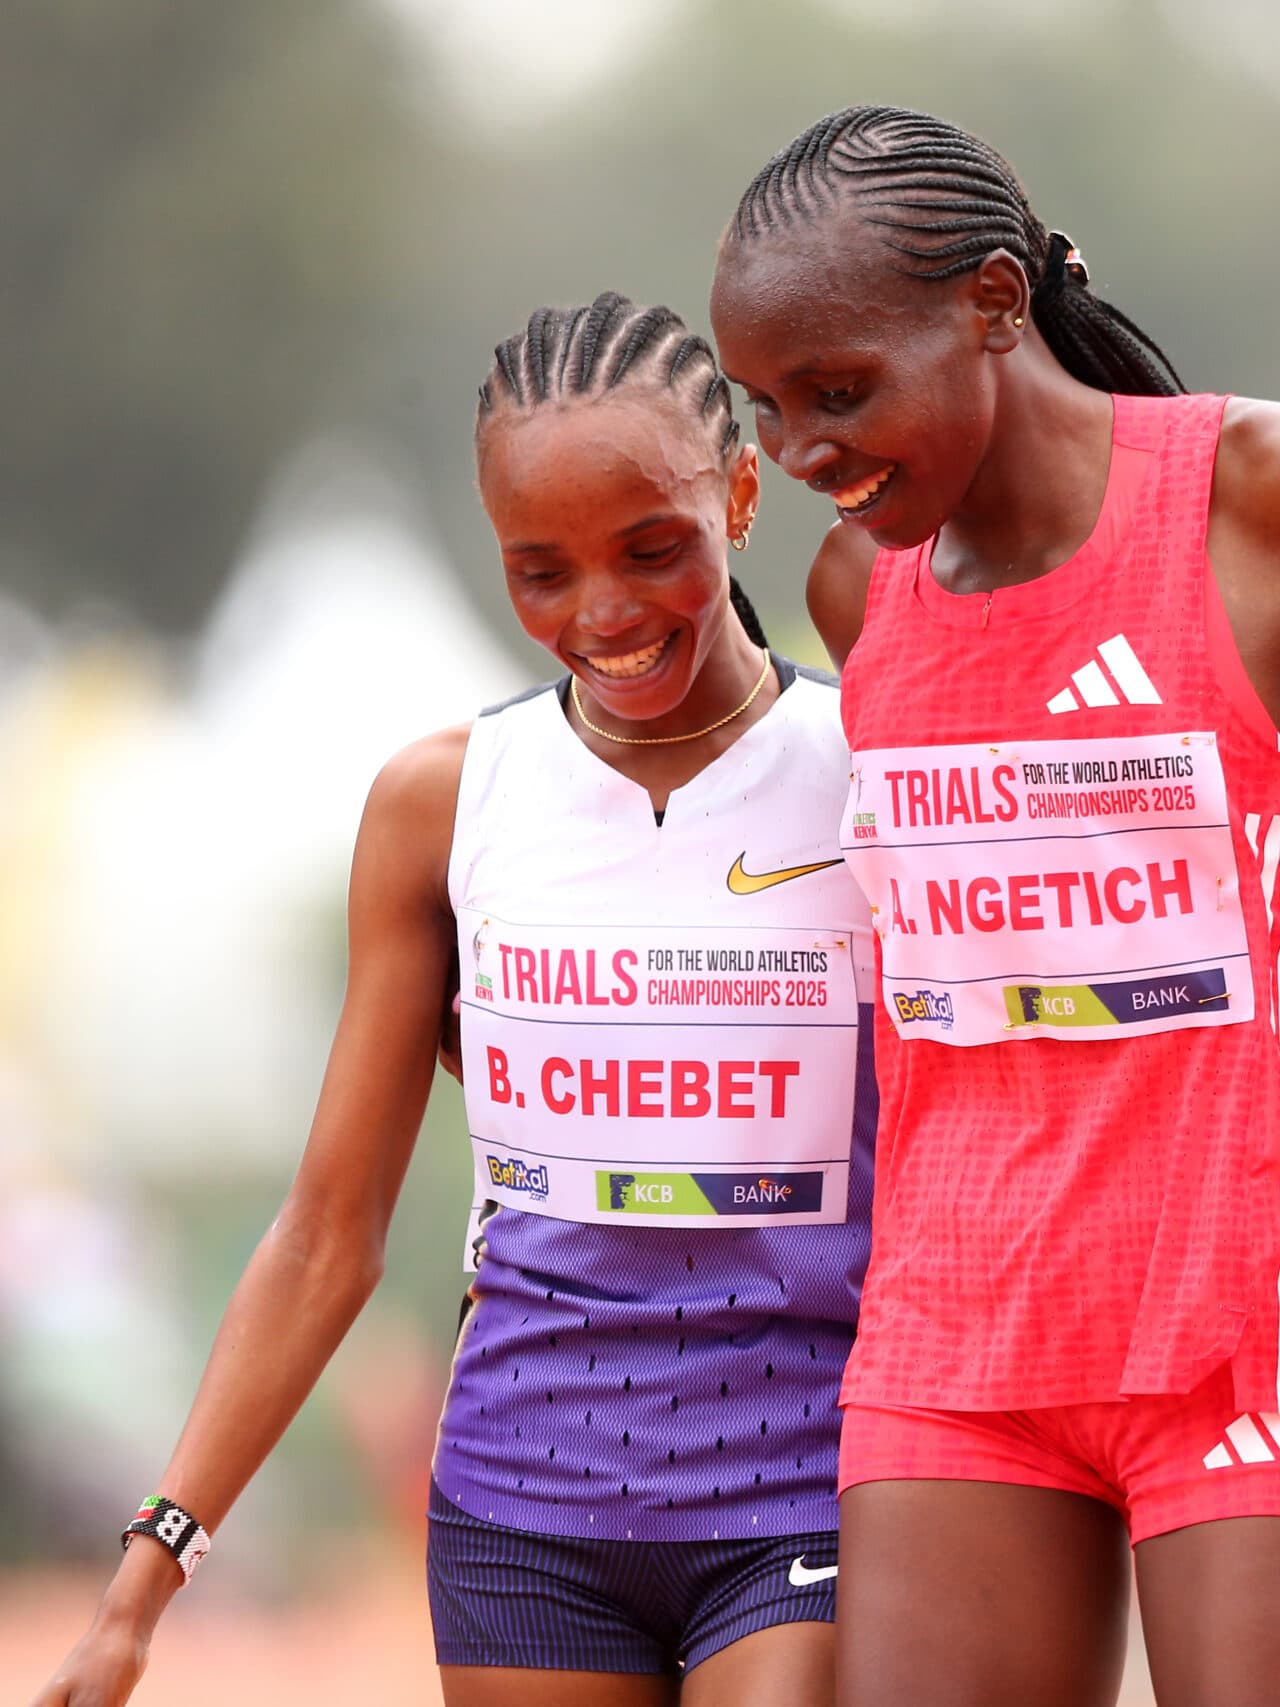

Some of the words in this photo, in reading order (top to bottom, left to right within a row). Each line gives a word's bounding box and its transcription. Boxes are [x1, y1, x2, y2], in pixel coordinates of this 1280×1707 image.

[1022, 763, 1046, 785] FOR
[1046, 762, 1070, 785] THE
[1072, 760, 1119, 785] WORLD
[1121, 754, 1194, 782] ATHLETICS
[884, 765, 1019, 828] TRIALS
[1027, 788, 1149, 819] CHAMPIONSHIPS
[1151, 785, 1196, 812] 2025
[890, 878, 918, 935] A.
[926, 859, 1194, 935] NGETICH
[498, 942, 638, 1006] TRIALS
[648, 949, 673, 972] FOR
[677, 949, 703, 972] THE
[706, 949, 754, 972] WORLD
[757, 950, 828, 973] ATHLETICS
[647, 979, 780, 1006] CHAMPIONSHIPS
[785, 980, 827, 1006] 2025
[1042, 996, 1076, 1016] KCB
[1131, 985, 1190, 1011] BANK
[486, 1045, 526, 1109] B.
[540, 1056, 800, 1118] CHEBET
[634, 1184, 673, 1203] KCB
[733, 1184, 787, 1204] BANK
